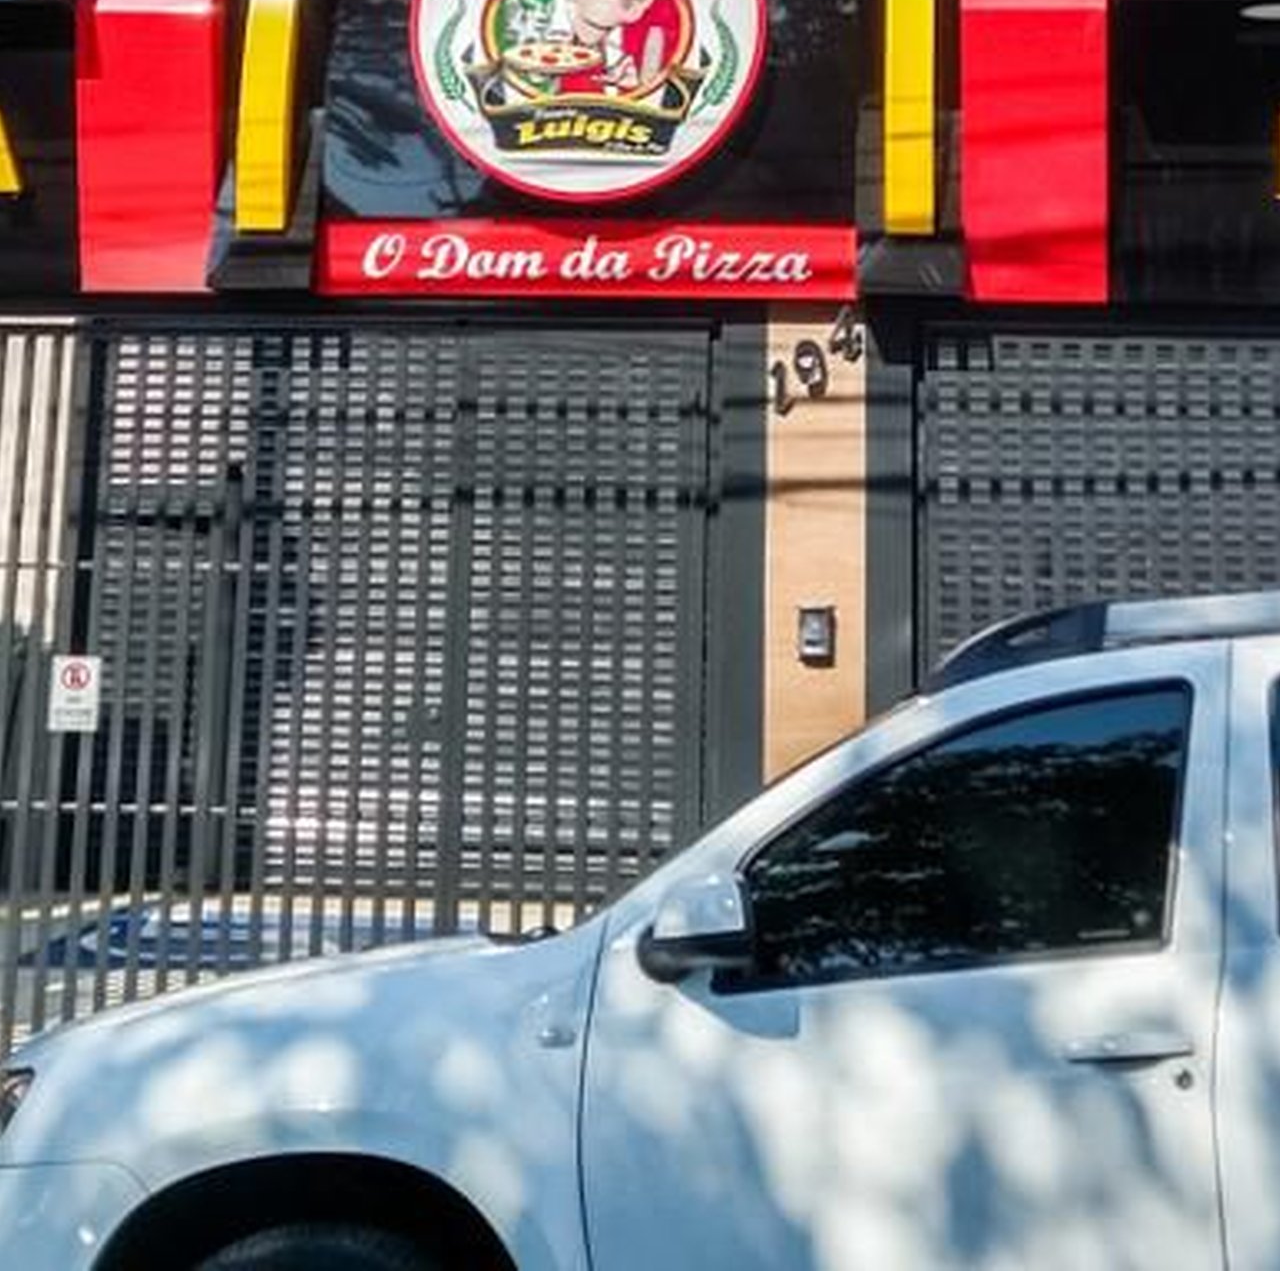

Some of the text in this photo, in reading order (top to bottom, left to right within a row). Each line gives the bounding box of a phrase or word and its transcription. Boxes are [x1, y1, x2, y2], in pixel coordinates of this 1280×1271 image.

[515, 113, 653, 145] Luigis
[361, 233, 813, 284] O Dom da Pizza
